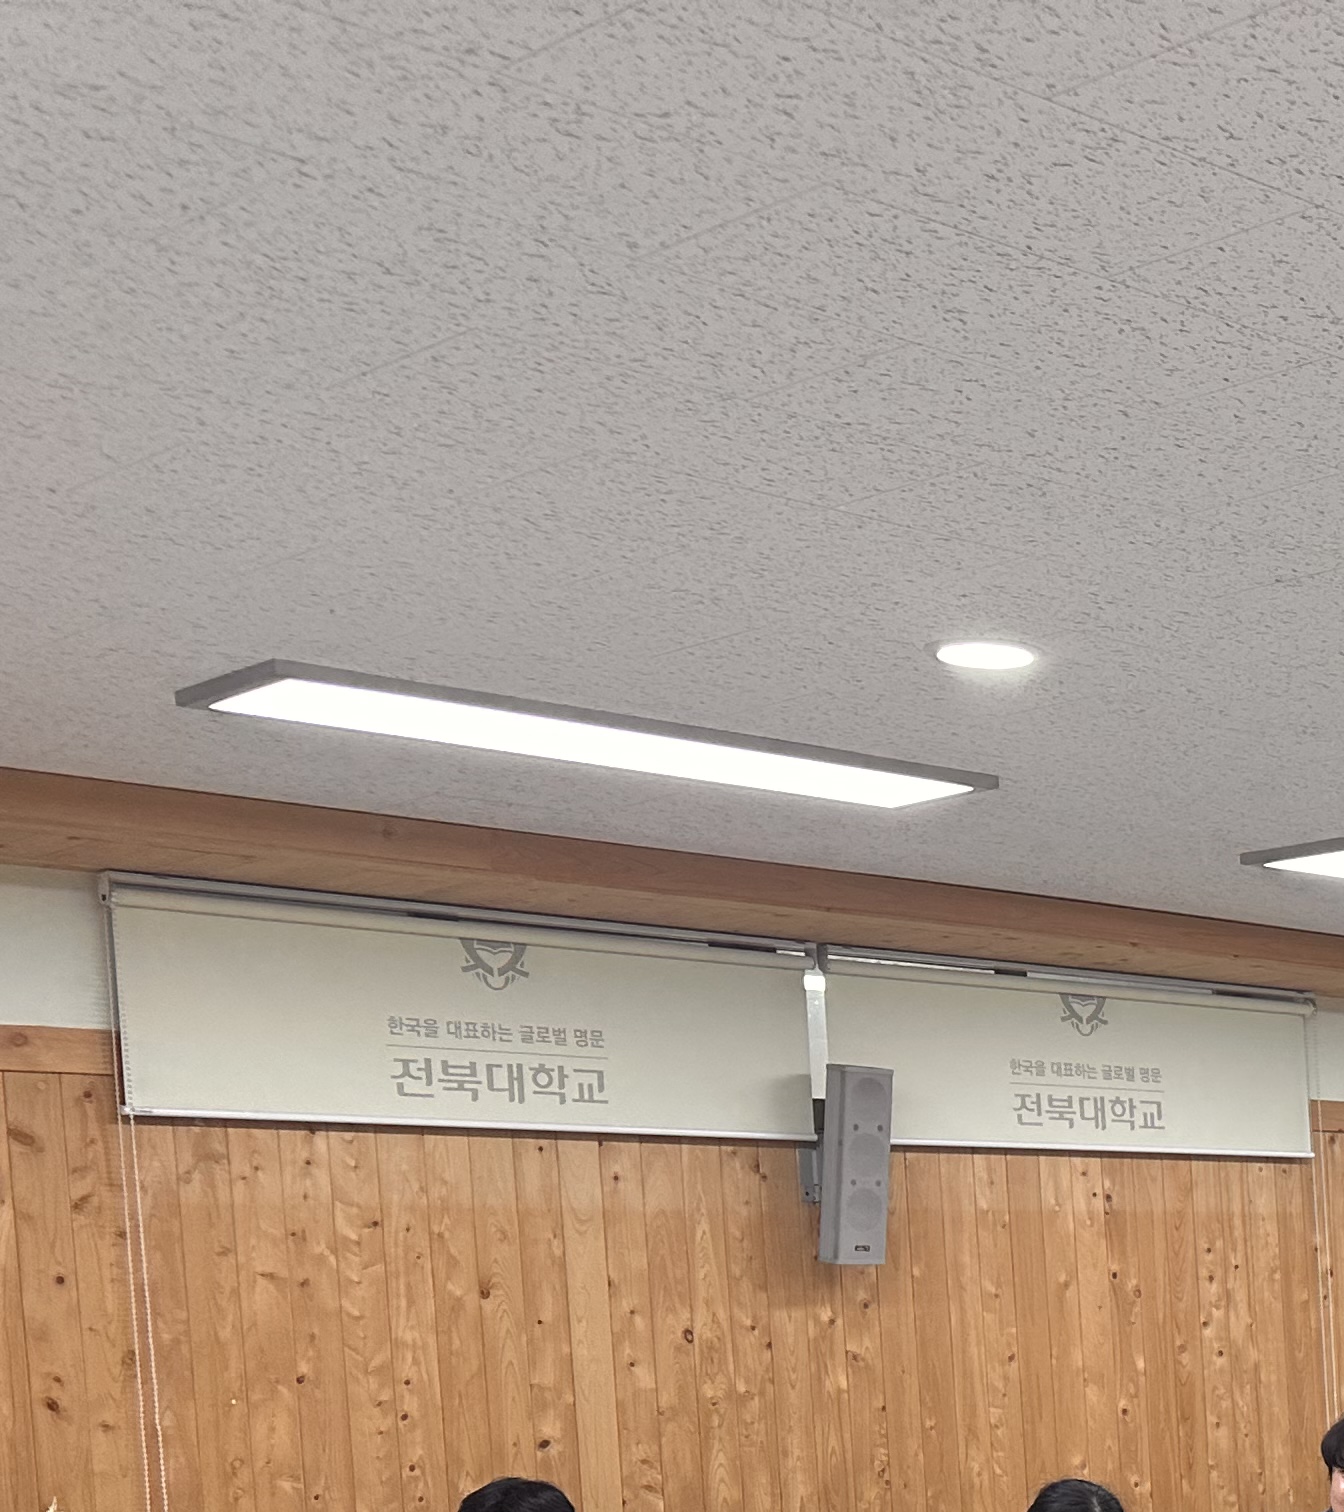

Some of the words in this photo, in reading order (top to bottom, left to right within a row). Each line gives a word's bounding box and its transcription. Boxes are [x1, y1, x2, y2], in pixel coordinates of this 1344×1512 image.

[387, 1015, 439, 1039] 한국을
[446, 1020, 513, 1043] 대표하는
[518, 1024, 567, 1047] 글로벌
[573, 1028, 605, 1049] 명문
[390, 1057, 609, 1105] 전북대학교
[1009, 1058, 1046, 1077] 한국을
[1050, 1061, 1098, 1080] 대표하는
[1101, 1064, 1136, 1082] 글로벌
[1139, 1067, 1163, 1084] 명문
[1012, 1092, 1166, 1131] 전북대학교
